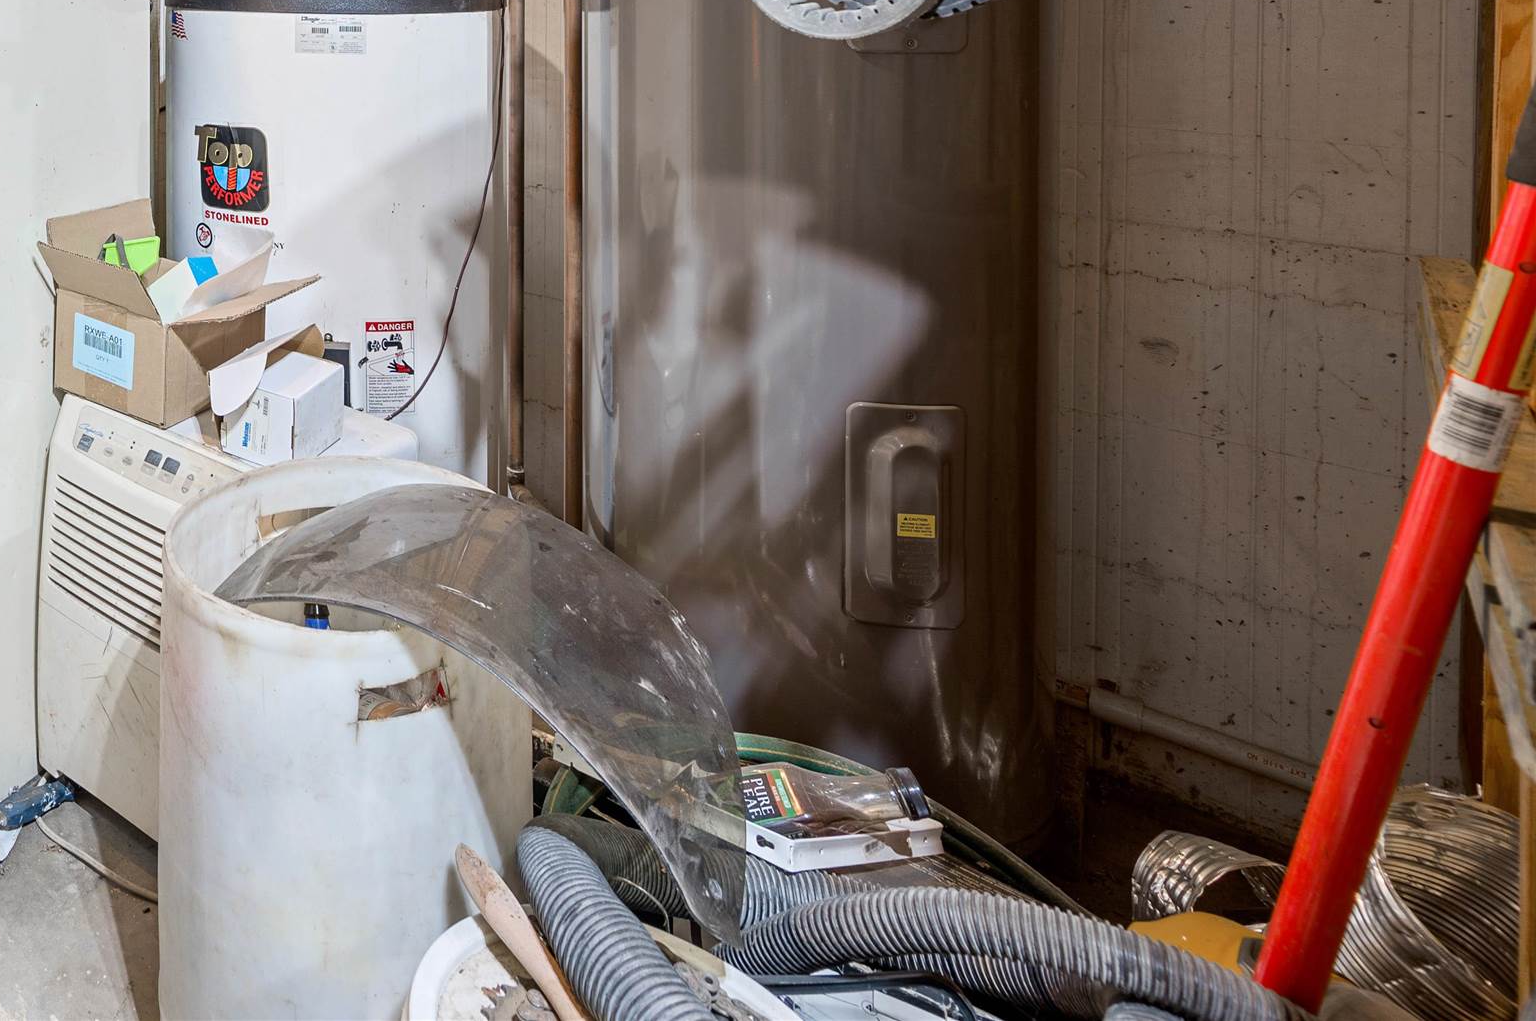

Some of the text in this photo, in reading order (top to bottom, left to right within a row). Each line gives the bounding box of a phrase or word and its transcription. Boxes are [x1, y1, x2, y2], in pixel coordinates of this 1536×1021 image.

[194, 124, 253, 168] Top
[203, 165, 264, 207] PERFORMER
[204, 210, 269, 226] STONELINED
[377, 322, 413, 331] DANGER
[751, 777, 776, 818] PURE
